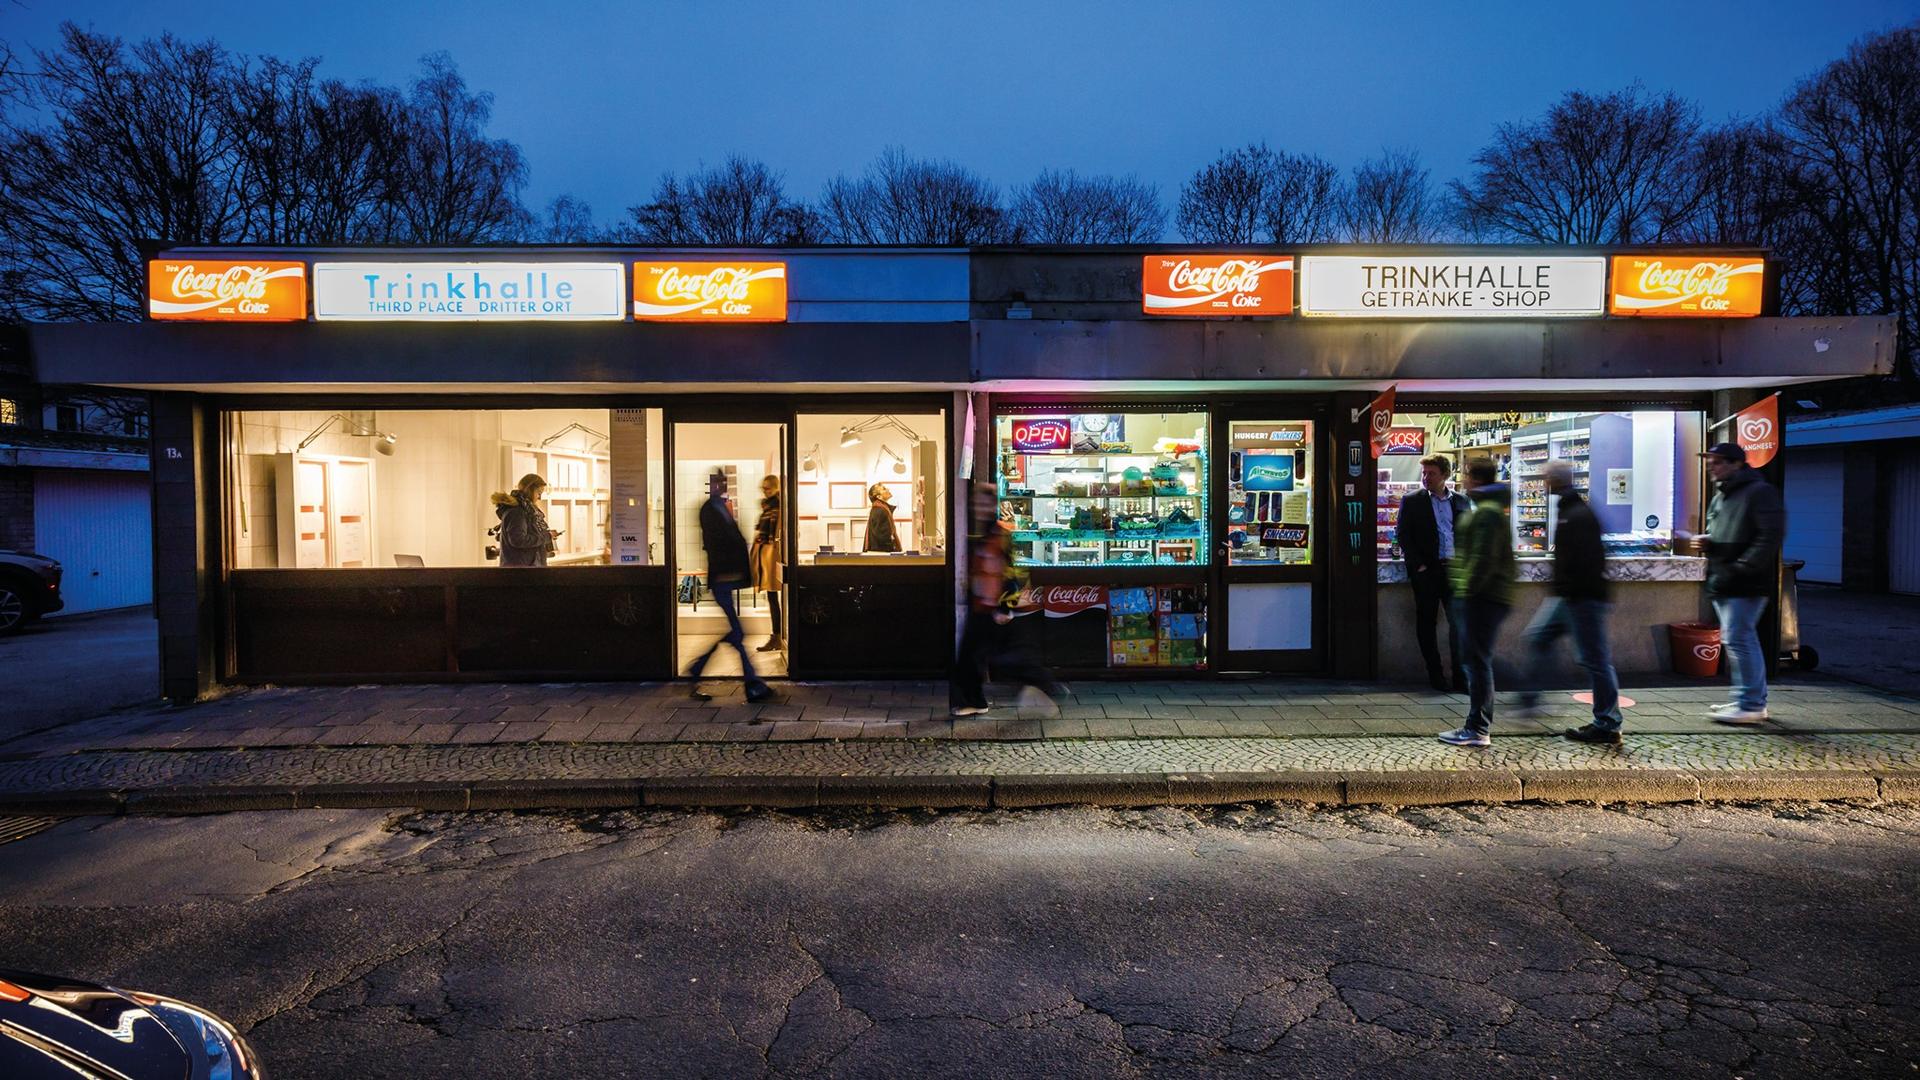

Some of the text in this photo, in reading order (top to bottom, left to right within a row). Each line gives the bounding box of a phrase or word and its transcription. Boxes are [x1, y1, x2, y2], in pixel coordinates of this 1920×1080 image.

[172, 264, 269, 299] Coca-Cola
[657, 267, 752, 300] Coca-Cola
[1168, 260, 1262, 293] Coca-Cola
[1361, 265, 1550, 289] TRINKHALLE
[1639, 261, 1733, 295] Coca-Cola
[364, 272, 573, 298] Trinkhalle
[1231, 293, 1262, 307] Coke
[1361, 290, 1472, 307] GETRÄNKE
[1492, 290, 1551, 307] SHOP
[1700, 295, 1730, 310] Coke
[238, 300, 269, 314] Coke
[369, 301, 571, 312] THIRD PLACE DRITTER ORT
[721, 301, 752, 314] Coke
[1015, 427, 1067, 442] OPEN
[1234, 432, 1268, 440] HUNGER?
[1743, 441, 1773, 450] ANGNESE
[1263, 529, 1305, 540] SNICKERS
[1048, 585, 1100, 604] Coca-Cola
